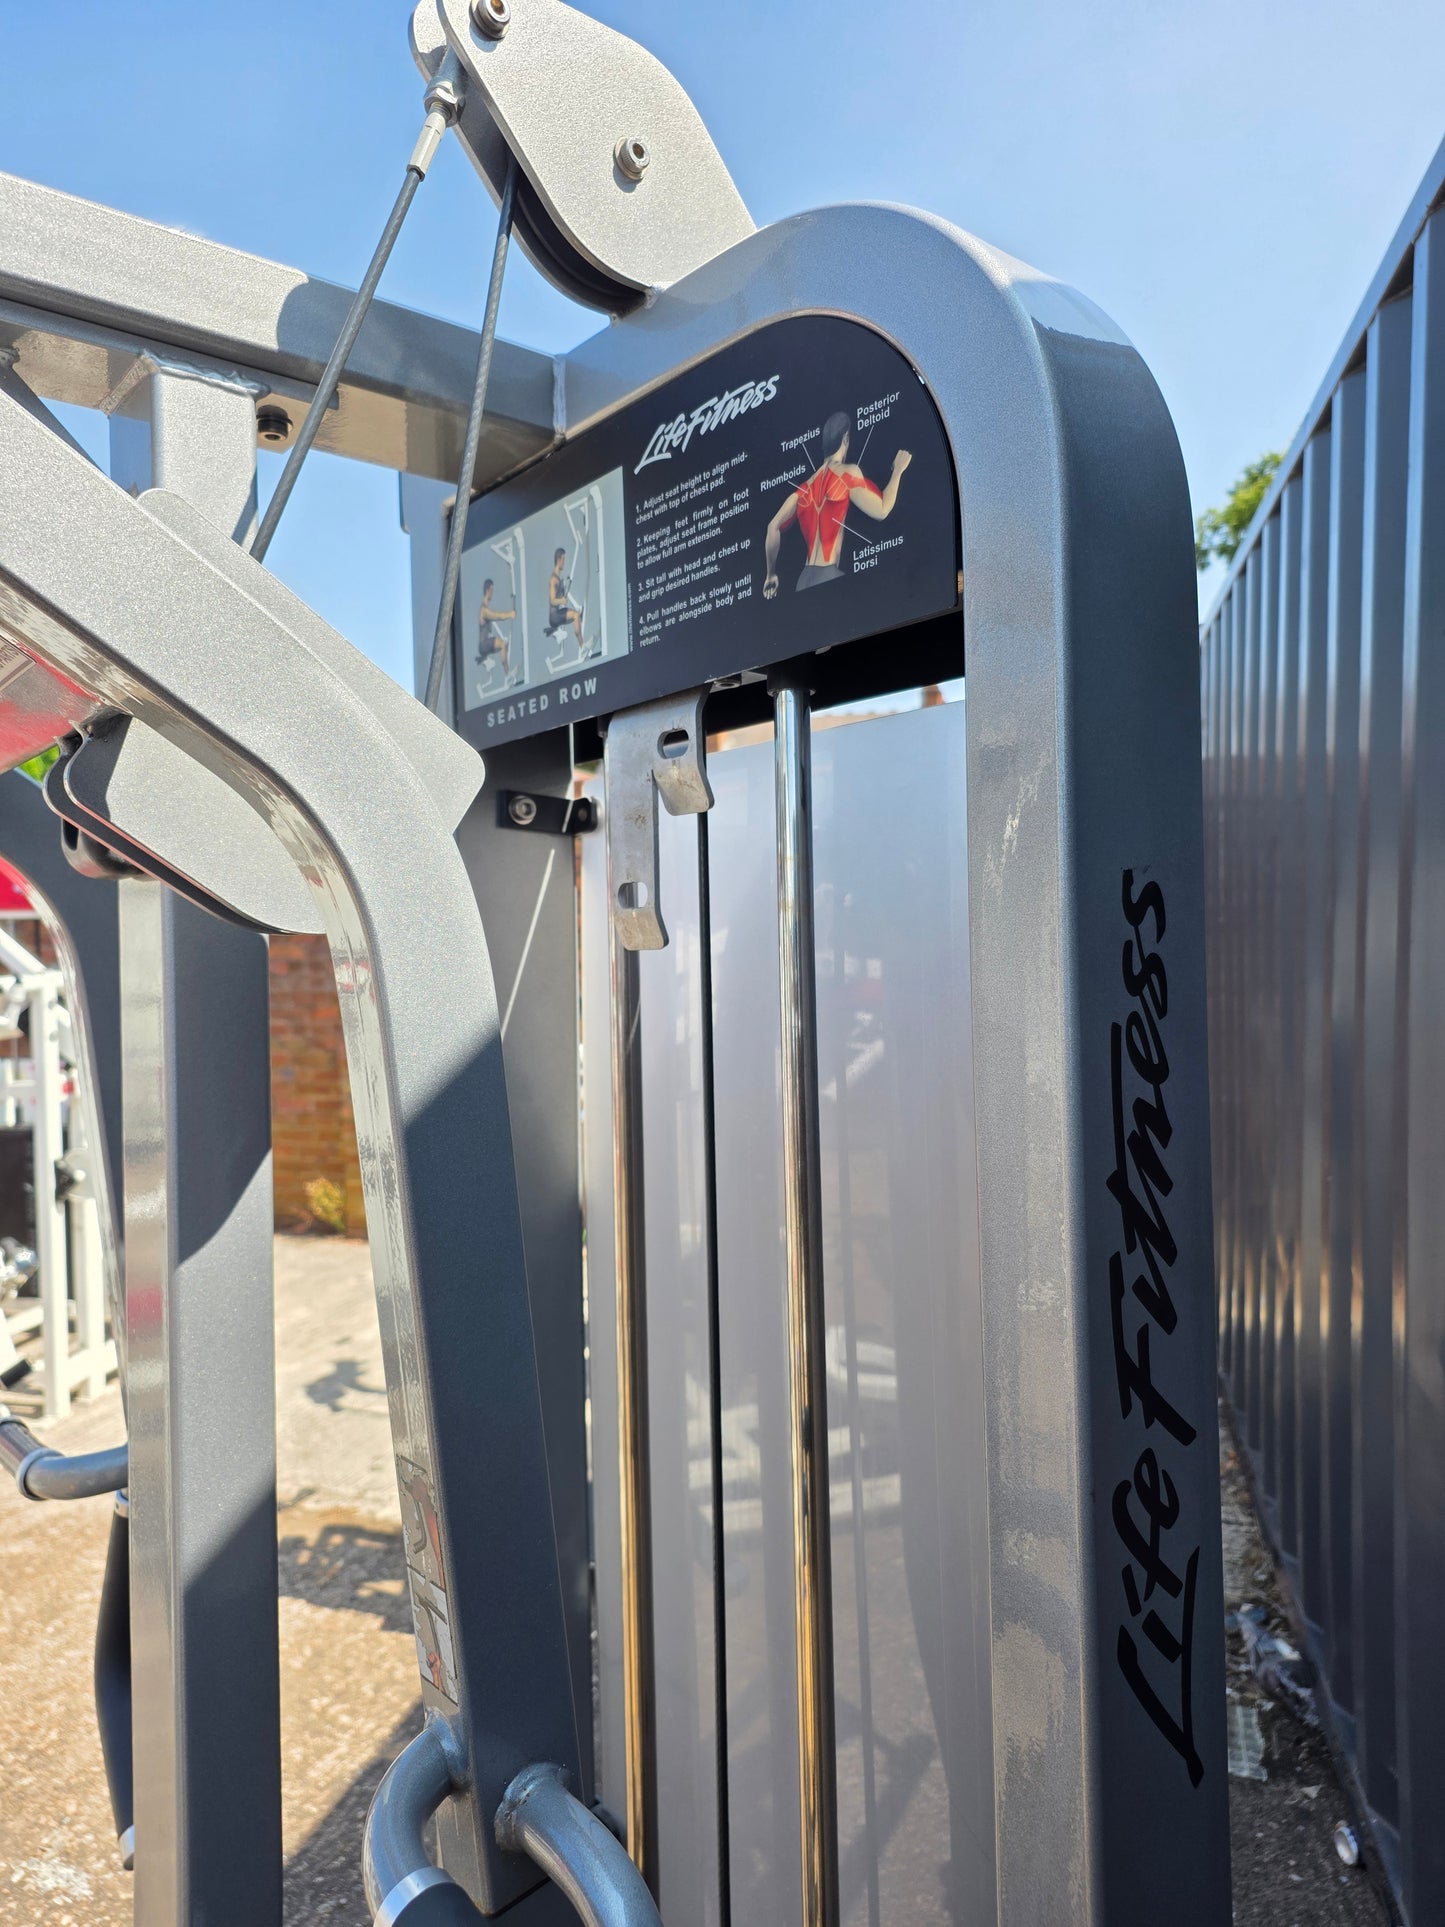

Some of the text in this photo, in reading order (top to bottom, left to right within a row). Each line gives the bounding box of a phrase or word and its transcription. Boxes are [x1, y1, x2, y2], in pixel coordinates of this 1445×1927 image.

[857, 392, 901, 419] Posterior
[857, 407, 891, 432] Deltoid
[781, 427, 821, 452] Trapezius
[636, 451, 748, 513] 1. Adjust seat height to align mid-
[760, 464, 806, 492] Rhomboids
[636, 475, 726, 525] chest with top of chest pad.
[637, 488, 749, 547] 2. Keeping feet firmly on foot
[637, 502, 750, 560] plates, adjust seat frame position
[637, 527, 723, 570] to allow full arm extension.
[853, 535, 904, 561] Latissimus
[639, 565, 721, 603] and grip desired handles.
[645, 577, 655, 589] Sit
[656, 572, 667, 584] tall
[668, 566, 682, 579] with
[684, 557, 701, 573] head
[703, 551, 716, 565] and
[718, 542, 738, 558] chest
[741, 539, 751, 550] up
[853, 556, 878, 573] Dorsi
[639, 573, 752, 625] 4. Pull handles back slowly until
[640, 586, 752, 636] elbows are alongside body and
[640, 635, 661, 648] return.
[487, 677, 598, 728] SEATED ROW
